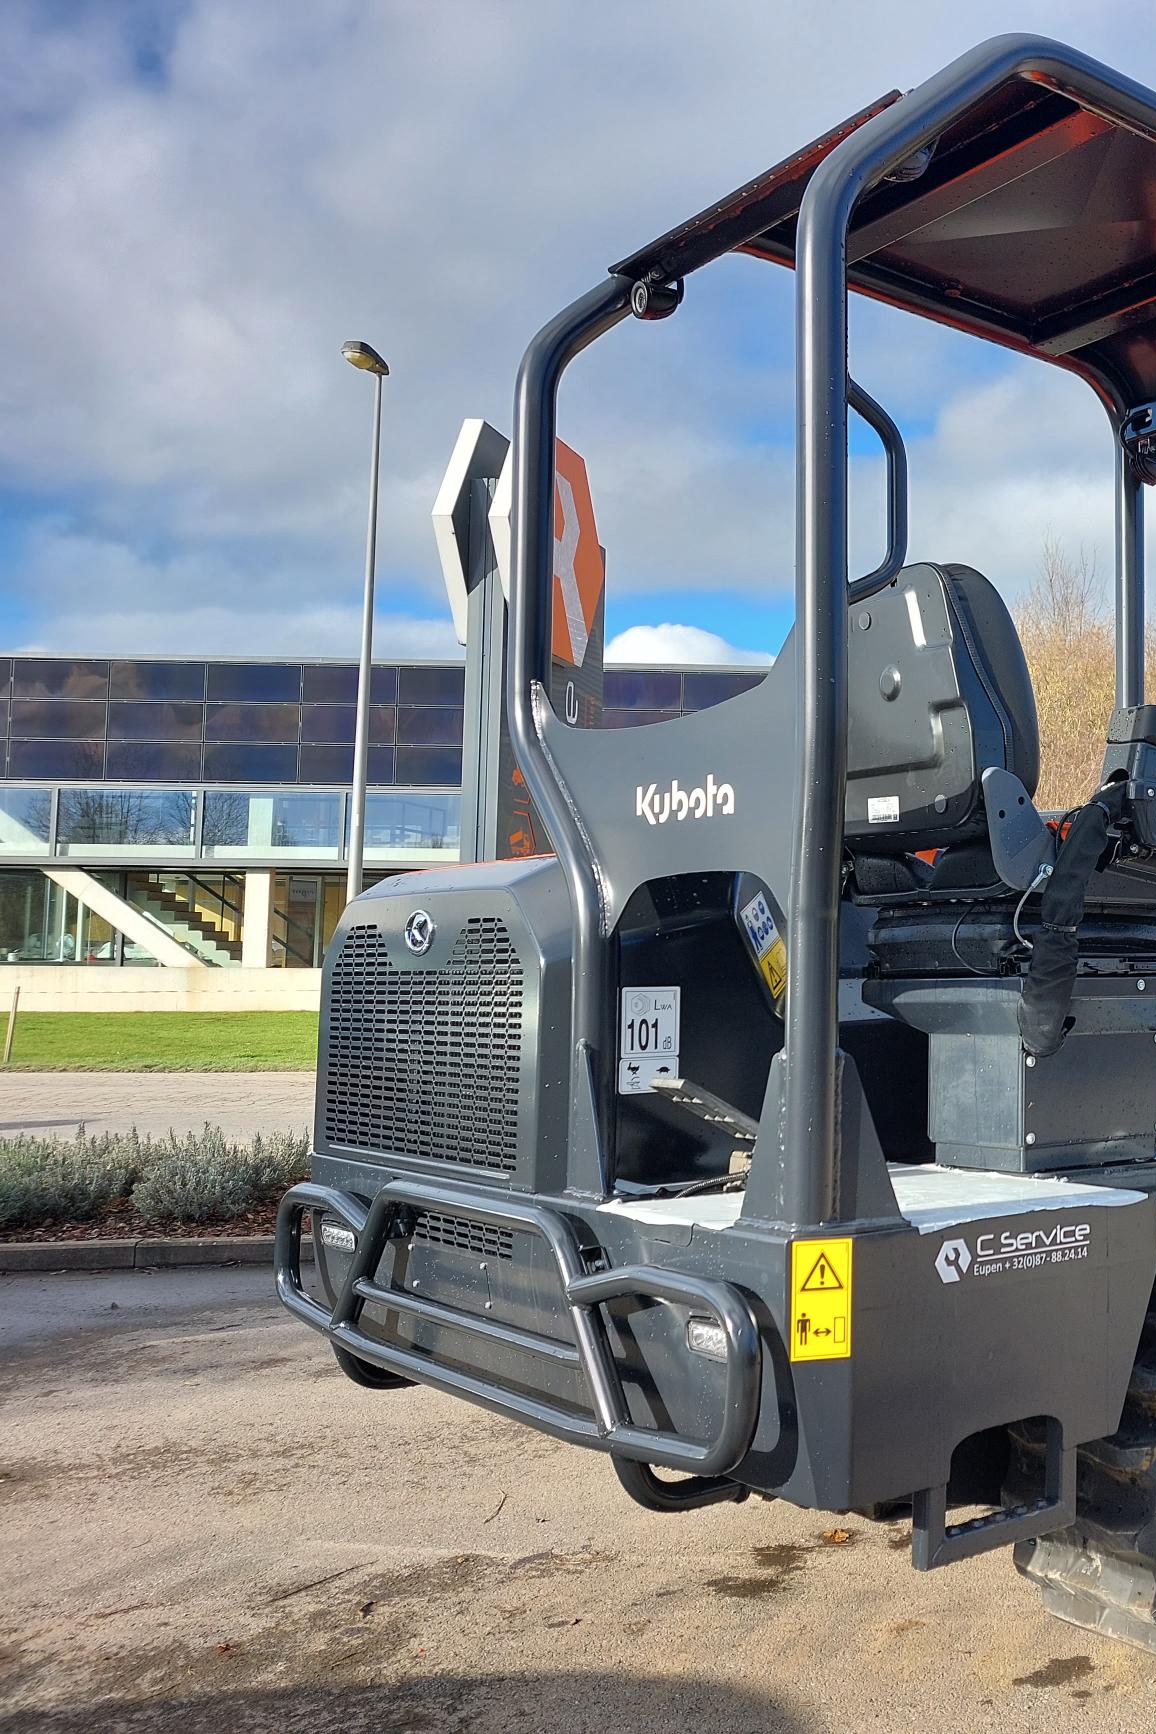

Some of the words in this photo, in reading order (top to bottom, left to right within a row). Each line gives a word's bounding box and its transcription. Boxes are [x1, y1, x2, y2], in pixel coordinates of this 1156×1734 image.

[636, 773, 735, 825] Kubota
[627, 1018, 659, 1051] 101
[976, 1233, 995, 1256] C
[1000, 1223, 1091, 1253] Service
[973, 1262, 1003, 1277] Eupen
